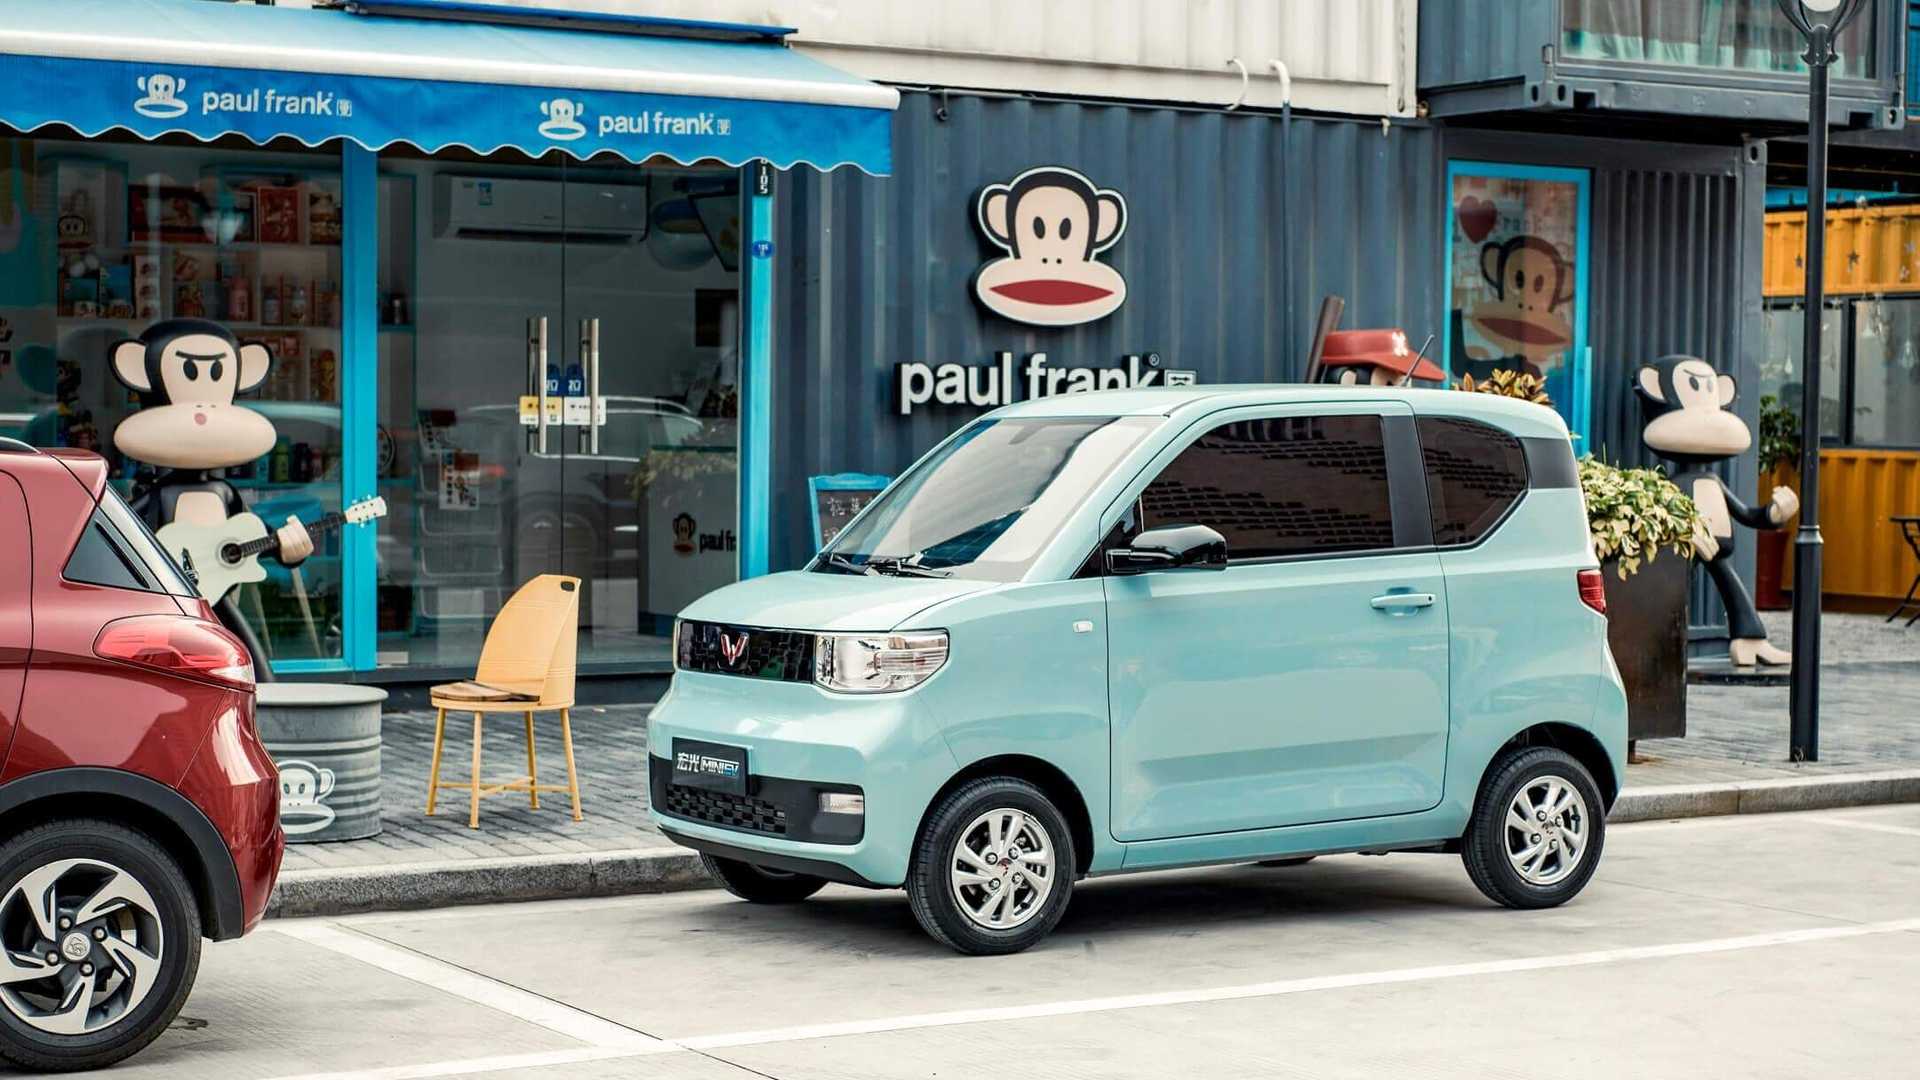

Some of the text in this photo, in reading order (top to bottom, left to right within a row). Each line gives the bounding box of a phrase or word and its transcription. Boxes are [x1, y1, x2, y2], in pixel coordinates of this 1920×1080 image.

[202, 88, 260, 115] paul
[599, 111, 649, 137] paul
[900, 352, 1012, 414] paul
[699, 529, 724, 553] paul
[677, 752, 700, 773] 宏光
